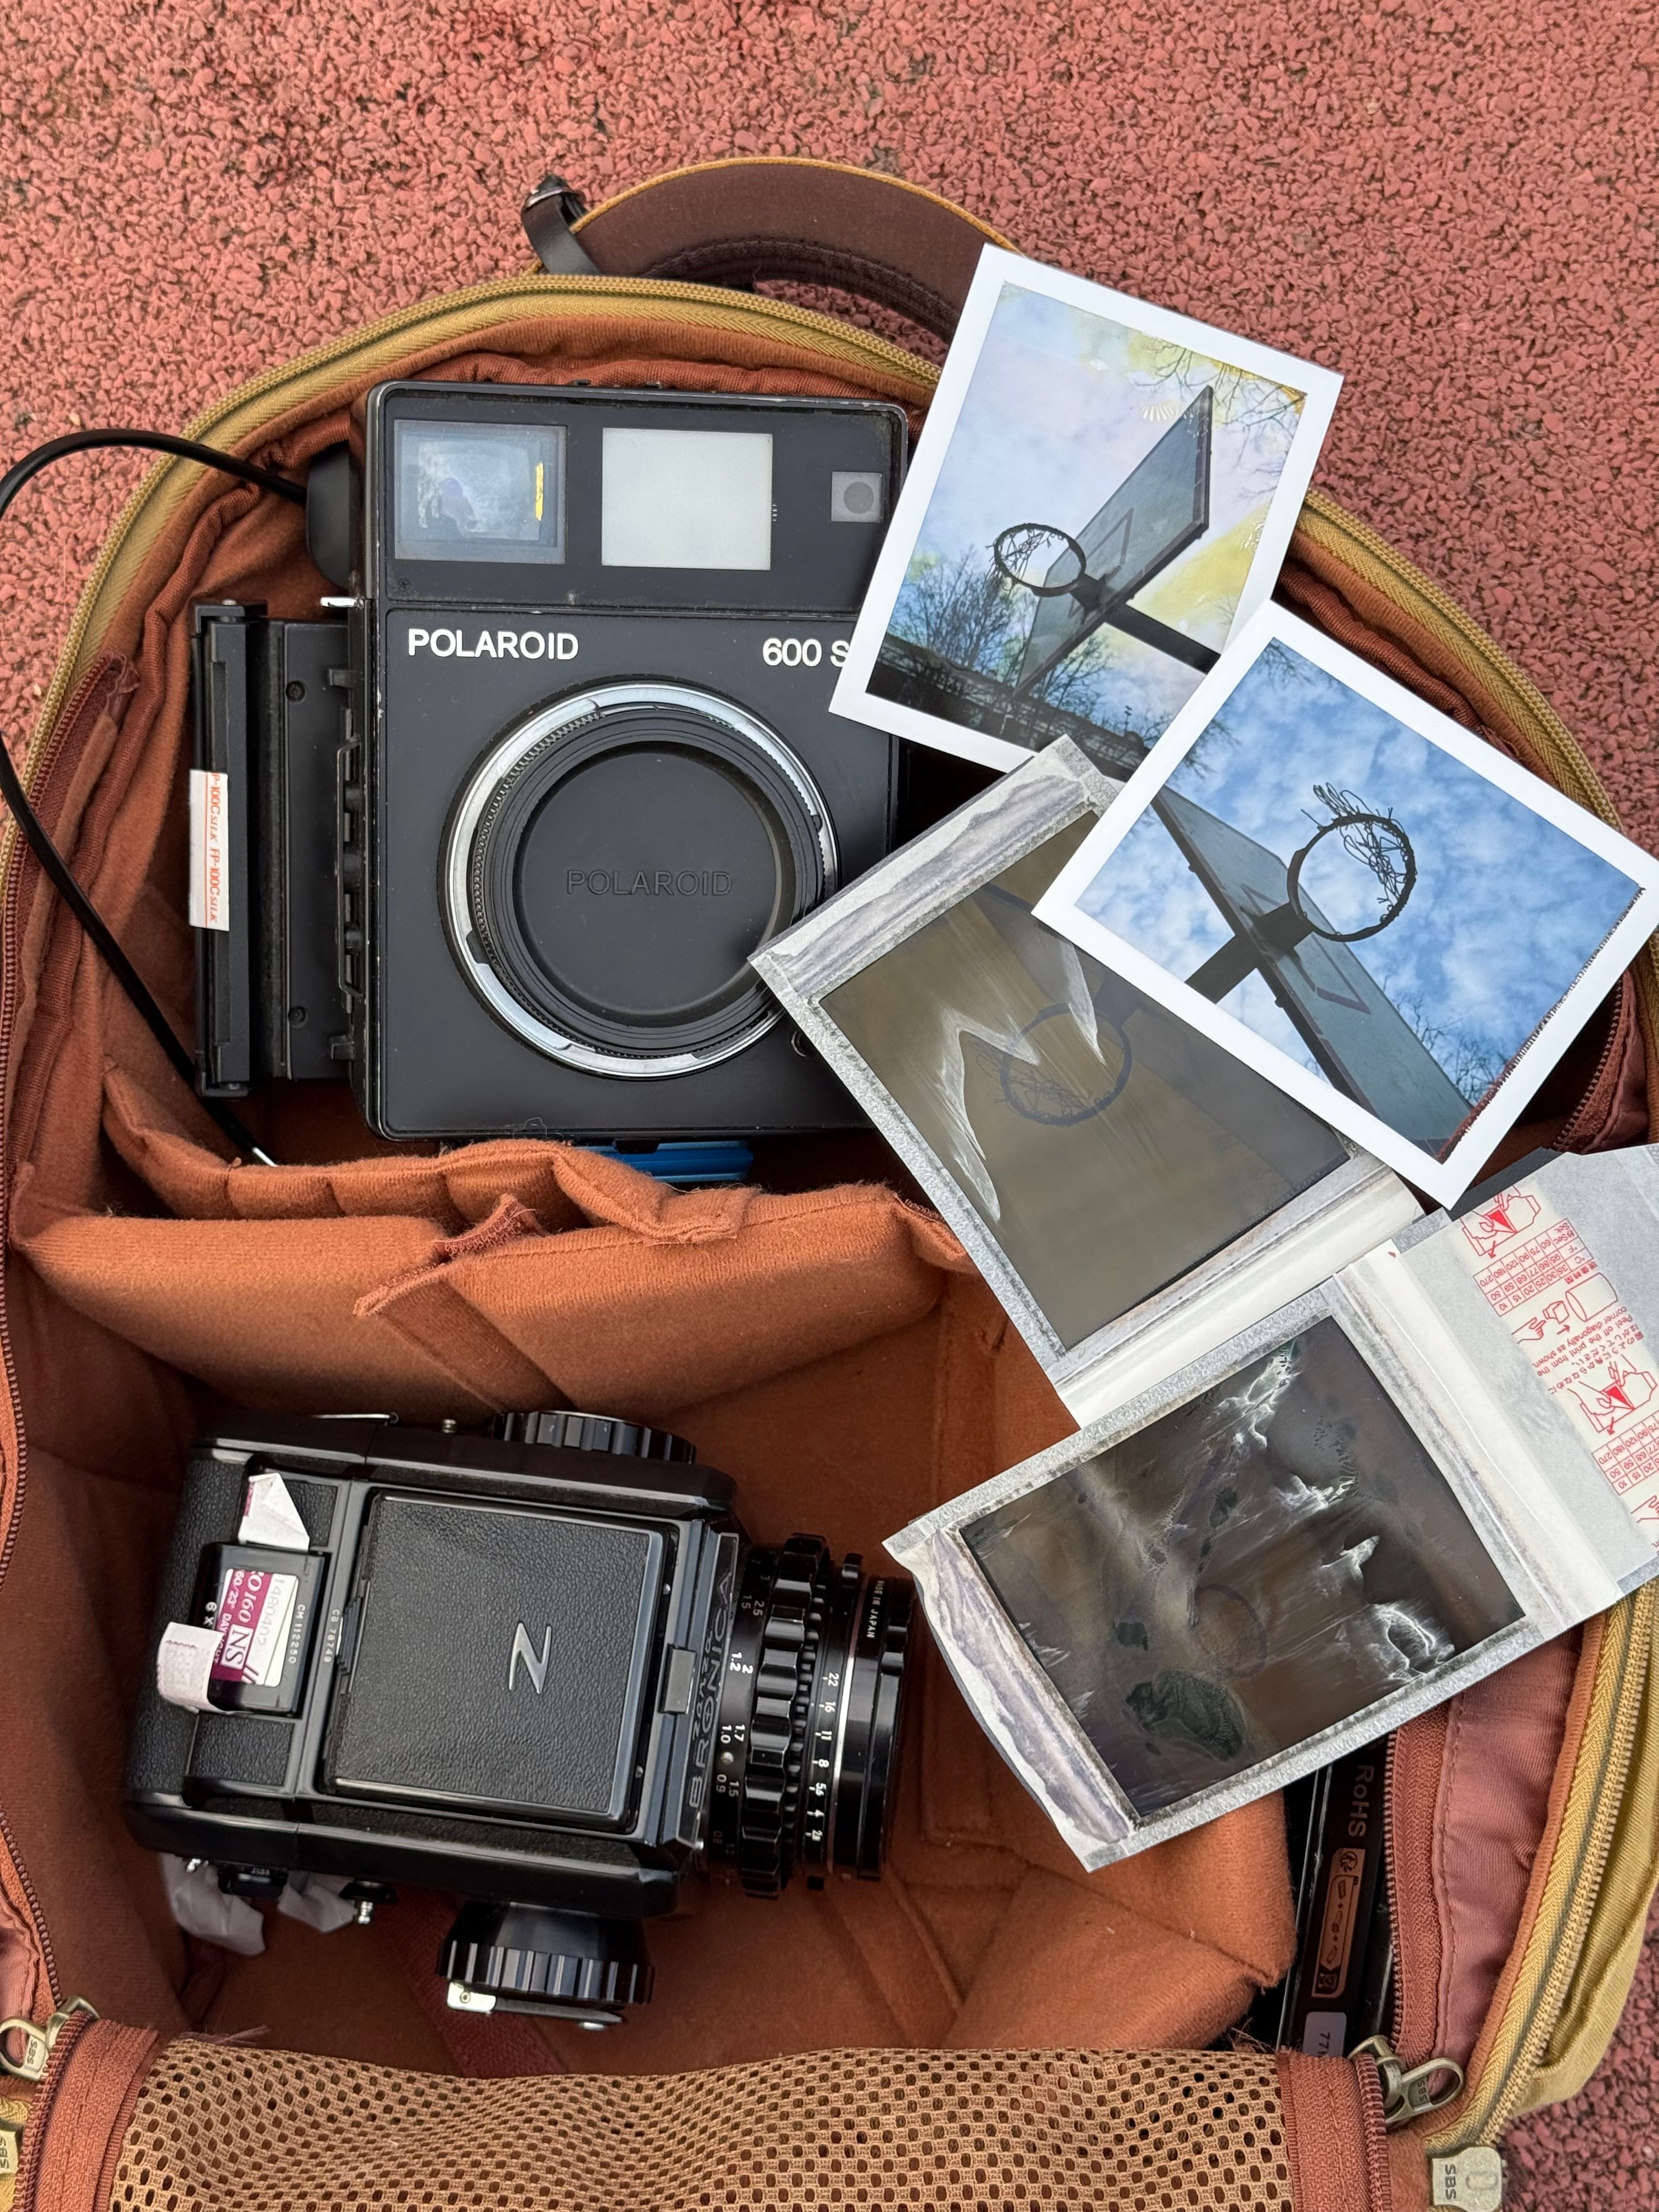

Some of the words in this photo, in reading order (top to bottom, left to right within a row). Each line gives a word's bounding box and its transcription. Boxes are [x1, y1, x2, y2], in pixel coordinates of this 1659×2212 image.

[409, 629, 578, 659] POLAROID
[763, 638, 822, 667] 600
[566, 868, 733, 898] POLAROID
[1541, 1239, 1551, 1249] 60
[1530, 1246, 1541, 1256] 75
[1519, 1252, 1530, 1262] 90
[1550, 1254, 1561, 1263] 95
[1506, 1260, 1519, 1270] 120
[1539, 1260, 1550, 1270] 86
[1556, 1265, 1568, 1274] 35
[1493, 1268, 1506, 1278] 180
[1530, 1267, 1539, 1277] 77
[1546, 1271, 1557, 1281] 30
[1480, 1275, 1493, 1287] 270
[1516, 1274, 1527, 1284] 68
[1536, 1278, 1546, 1288] 25
[1504, 1282, 1515, 1292] 59
[1523, 1285, 1534, 1295] 20
[1491, 1290, 1501, 1301] 50
[1513, 1294, 1522, 1302] 15
[1604, 1306, 1627, 1324] corner
[1615, 1314, 1633, 1328] Peel
[1567, 1322, 1602, 1347] diagonally
[1603, 1326, 1613, 1336] off
[1589, 1334, 1602, 1344] the
[1556, 1345, 1566, 1353] as
[1569, 1341, 1587, 1357] print
[1532, 1350, 1556, 1368] shown.
[1551, 1355, 1569, 1368] from
[1537, 1366, 1550, 1376] the
[1648, 1423, 1659, 1435] 75
[1638, 1429, 1648, 1442] 90
[1625, 1437, 1638, 1449] 120
[1612, 1444, 1626, 1458] 180
[1649, 1444, 1659, 1455] 77
[1598, 1452, 1612, 1464] 270
[1635, 1452, 1646, 1462] 68
[1624, 1459, 1634, 1470] 59
[1643, 1463, 1654, 1473] 20
[1610, 1468, 1621, 1479] 50
[1632, 1471, 1641, 1480] 15
[1618, 1480, 1627, 1489] 10
[741, 1595, 752, 1609] 1.5
[872, 1596, 881, 1605] IN
[206, 1600, 219, 1613] 6
[296, 1604, 306, 1619] CM
[753, 1600, 764, 1616] 2.5
[867, 1609, 878, 1638] JAPAN
[225, 1629, 252, 1666] NS
[288, 1623, 302, 1664] 112250
[730, 1652, 743, 1672] 1.2
[741, 1664, 754, 1674] 2
[826, 1673, 839, 1686] 22
[688, 1572, 731, 1807] BRONICA
[823, 1702, 836, 1713] 16
[721, 1725, 732, 1743] 1.0
[734, 1724, 745, 1741] 1.7
[820, 1731, 832, 1740] 11
[817, 1759, 830, 1768] 8
[716, 1774, 727, 1792] 0.9
[729, 1781, 740, 1797] 1.5
[1348, 1765, 1374, 1837] RoHS
[1418, 2079, 1426, 2102] SBS
[1444, 2163, 1457, 2200] SBS
